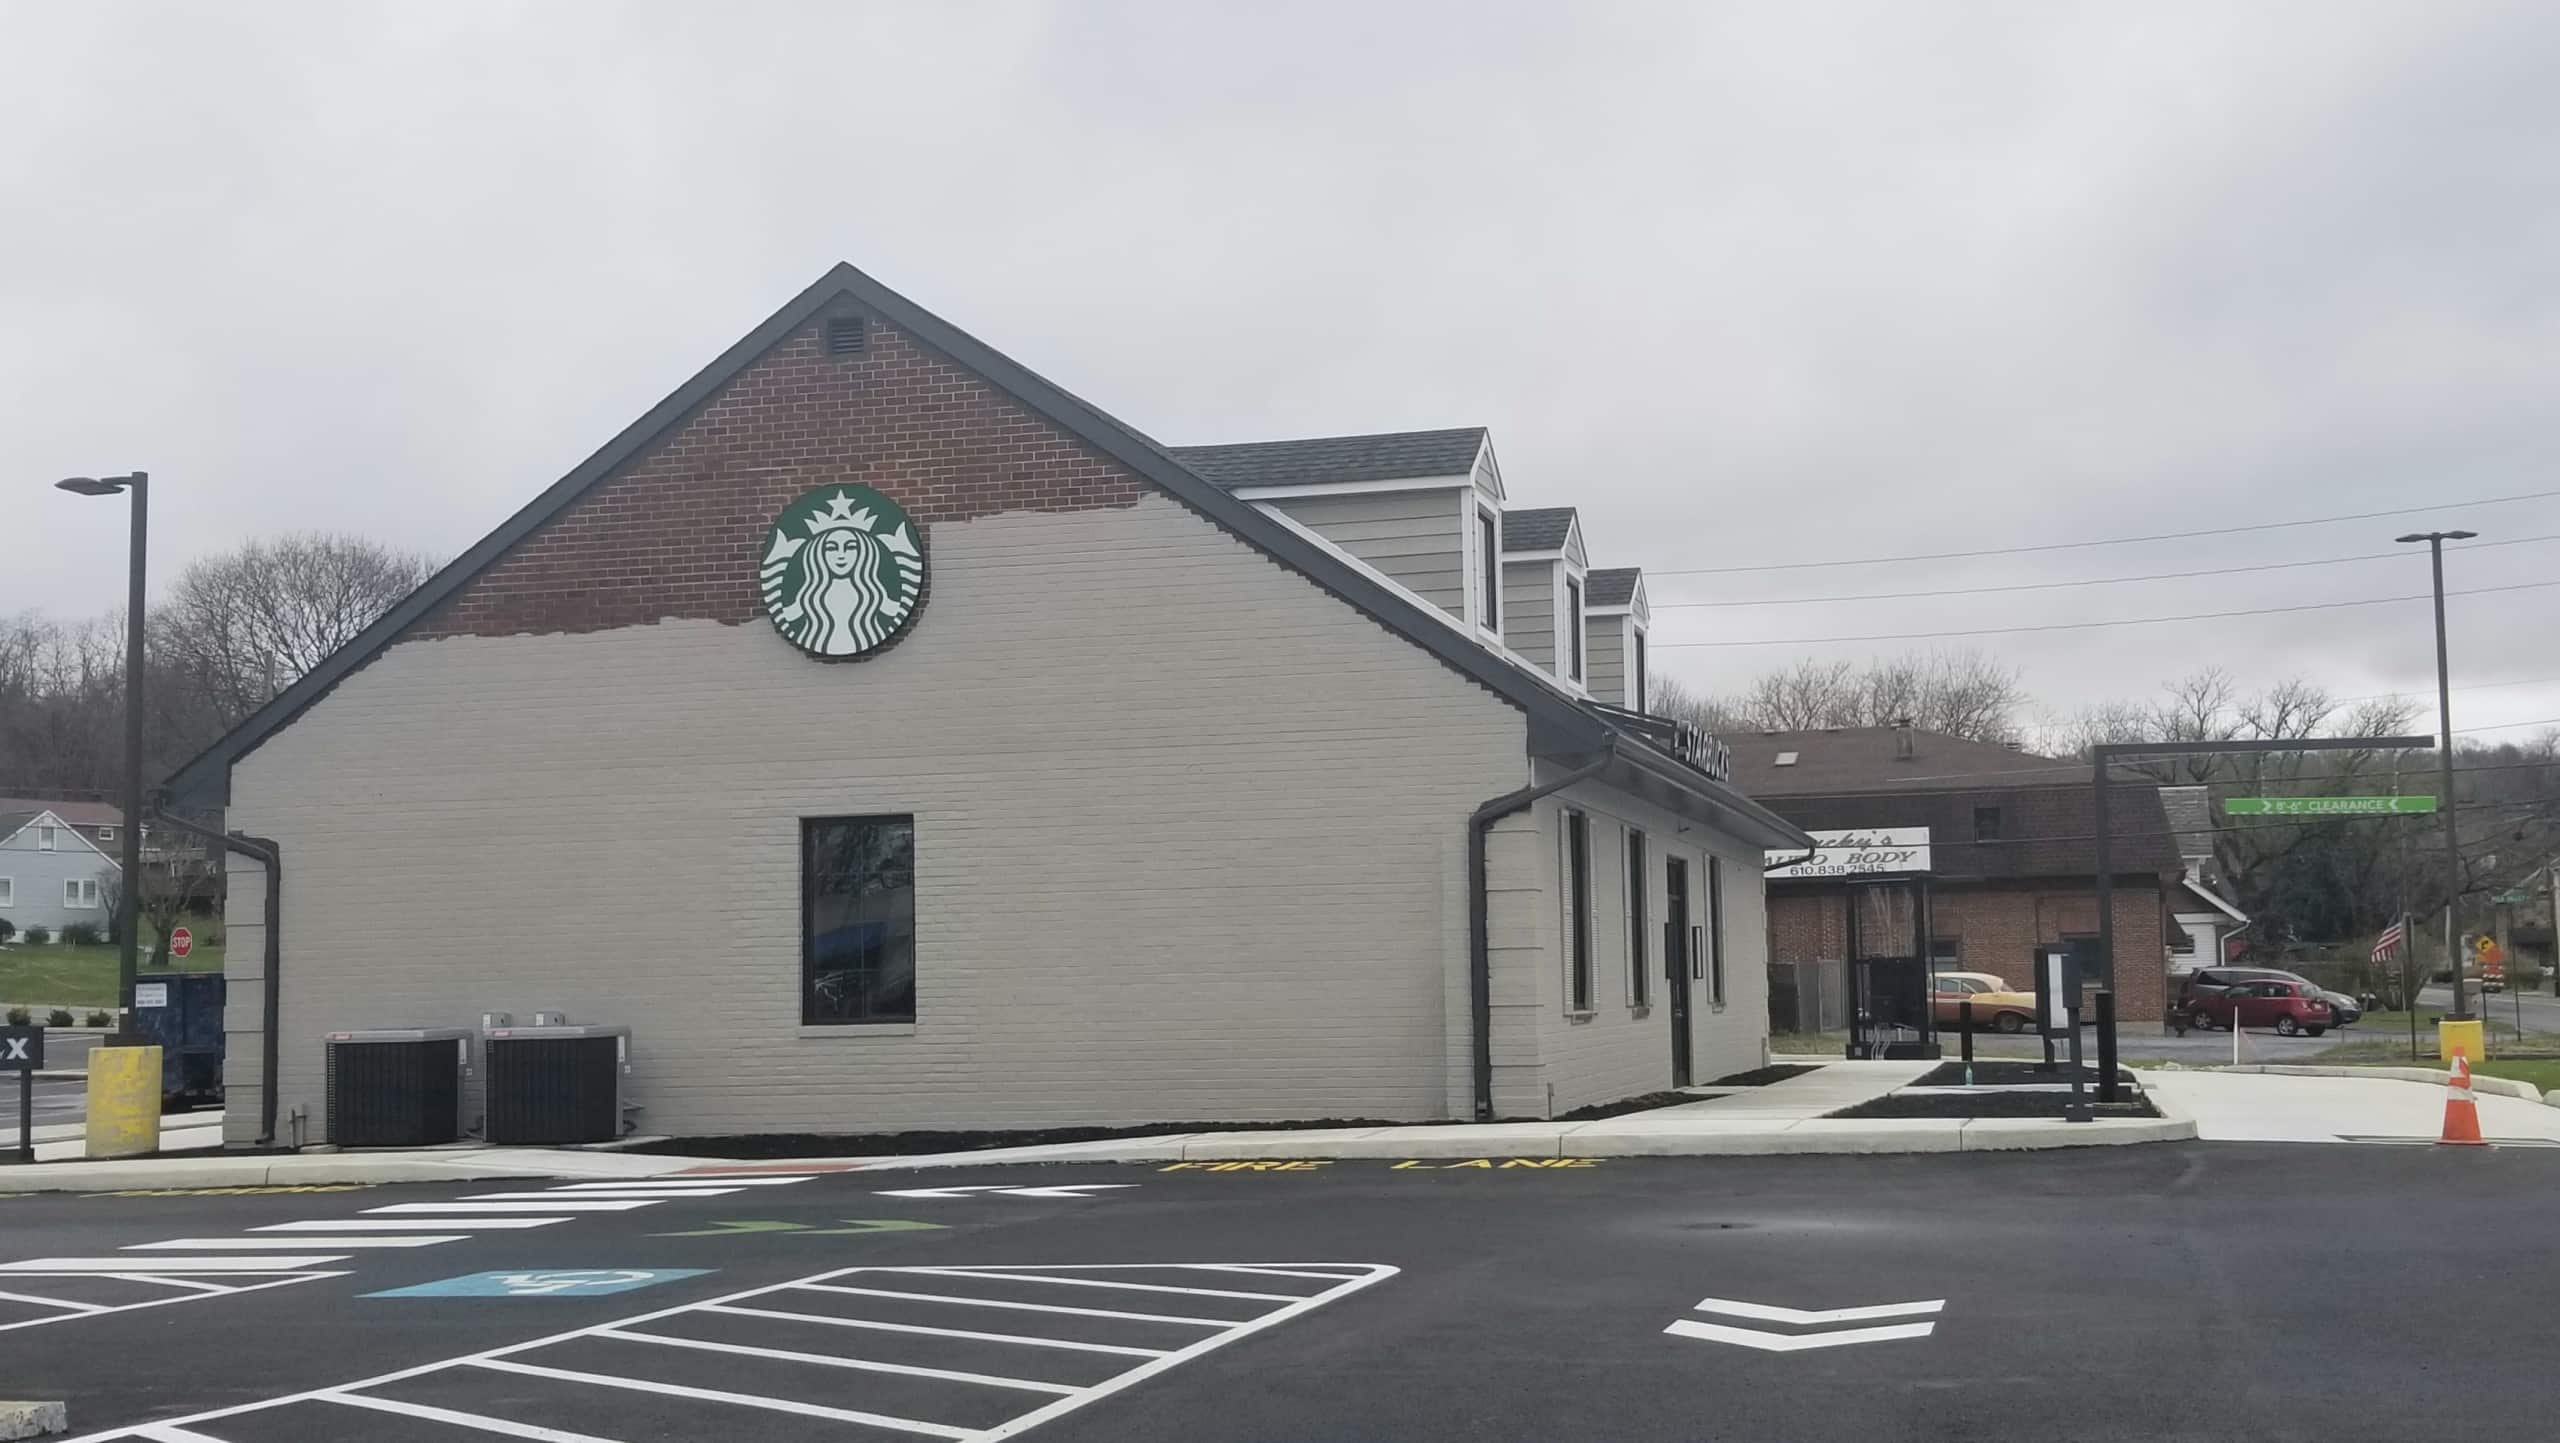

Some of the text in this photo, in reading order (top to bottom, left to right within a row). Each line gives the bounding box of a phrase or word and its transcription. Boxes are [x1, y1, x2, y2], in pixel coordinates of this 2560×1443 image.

[2308, 800, 2385, 811] CLEARANCE
[1814, 831, 1893, 852] ucky's
[1844, 850, 1918, 865] BODY
[172, 936, 191, 948] STOP
[1156, 1158, 1608, 1172] FIRE LANE
